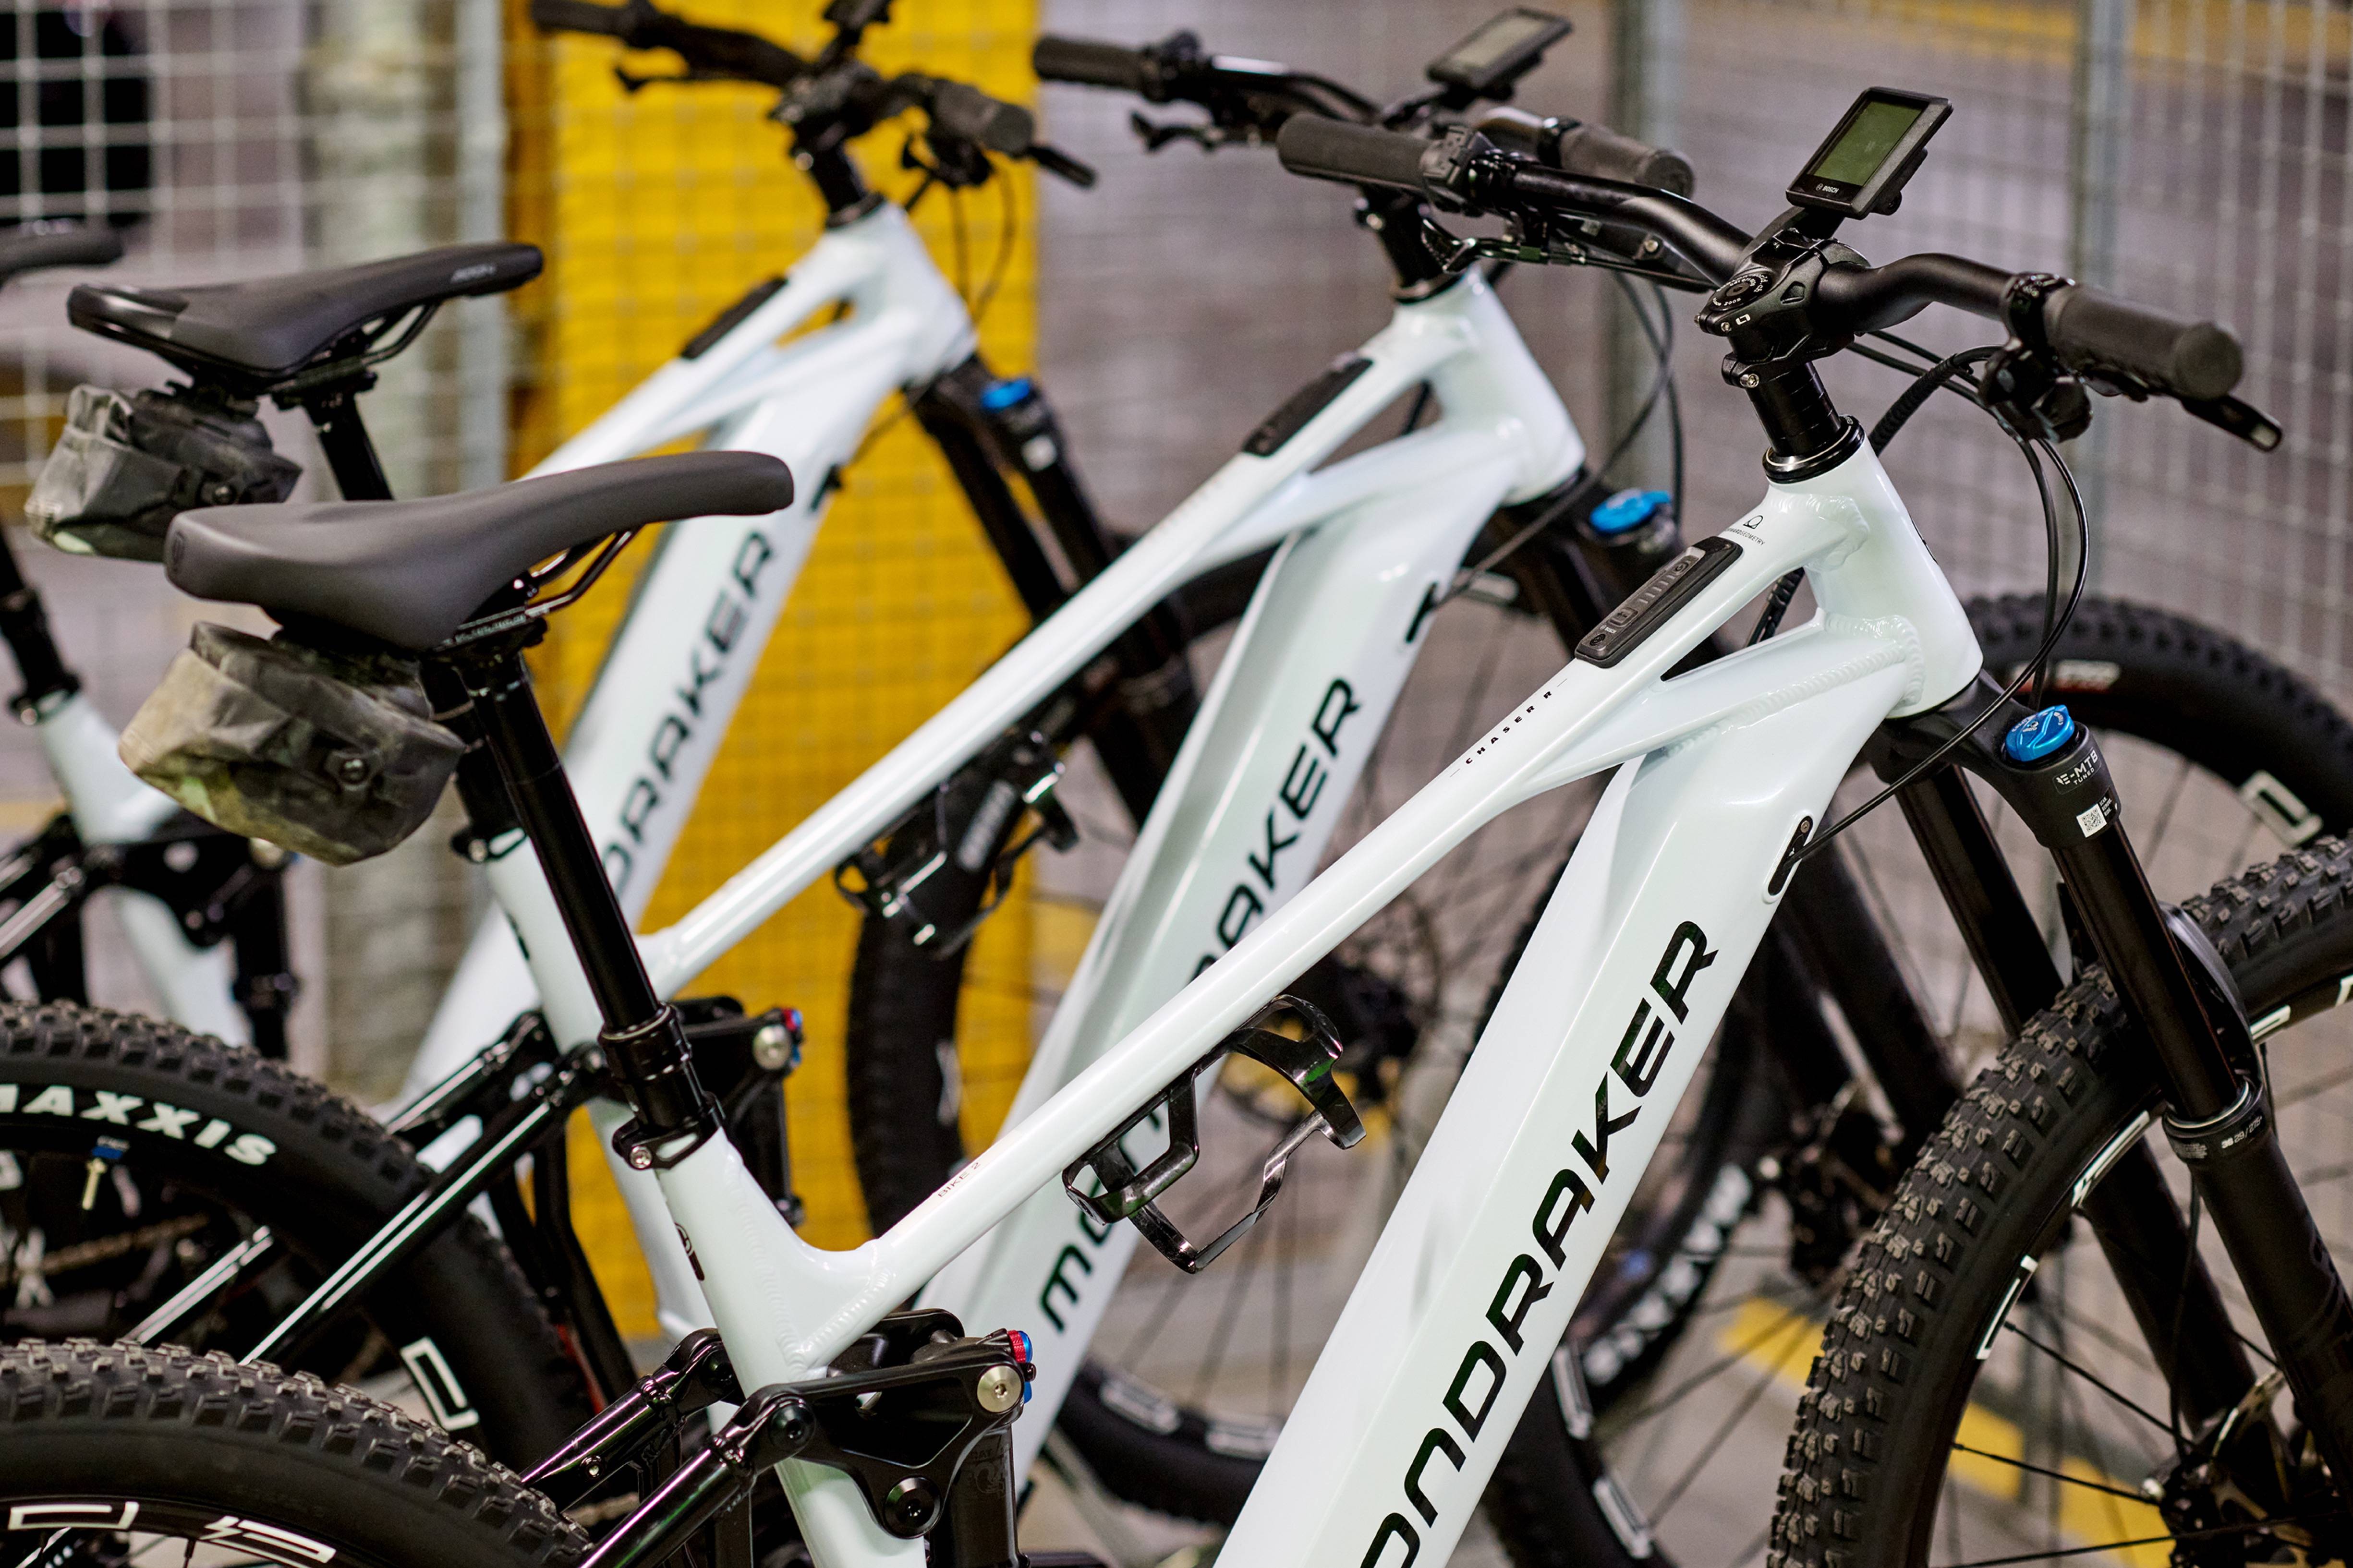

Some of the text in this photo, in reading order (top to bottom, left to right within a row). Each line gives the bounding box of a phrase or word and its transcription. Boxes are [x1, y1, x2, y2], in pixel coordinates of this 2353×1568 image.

[1822, 185, 1840, 193] BOSCH
[1466, 706, 1535, 764] CHASER
[2056, 749, 2098, 785] E-MTB
[2073, 767, 2095, 785] TUNED
[938, 1171, 970, 1197] BIKE
